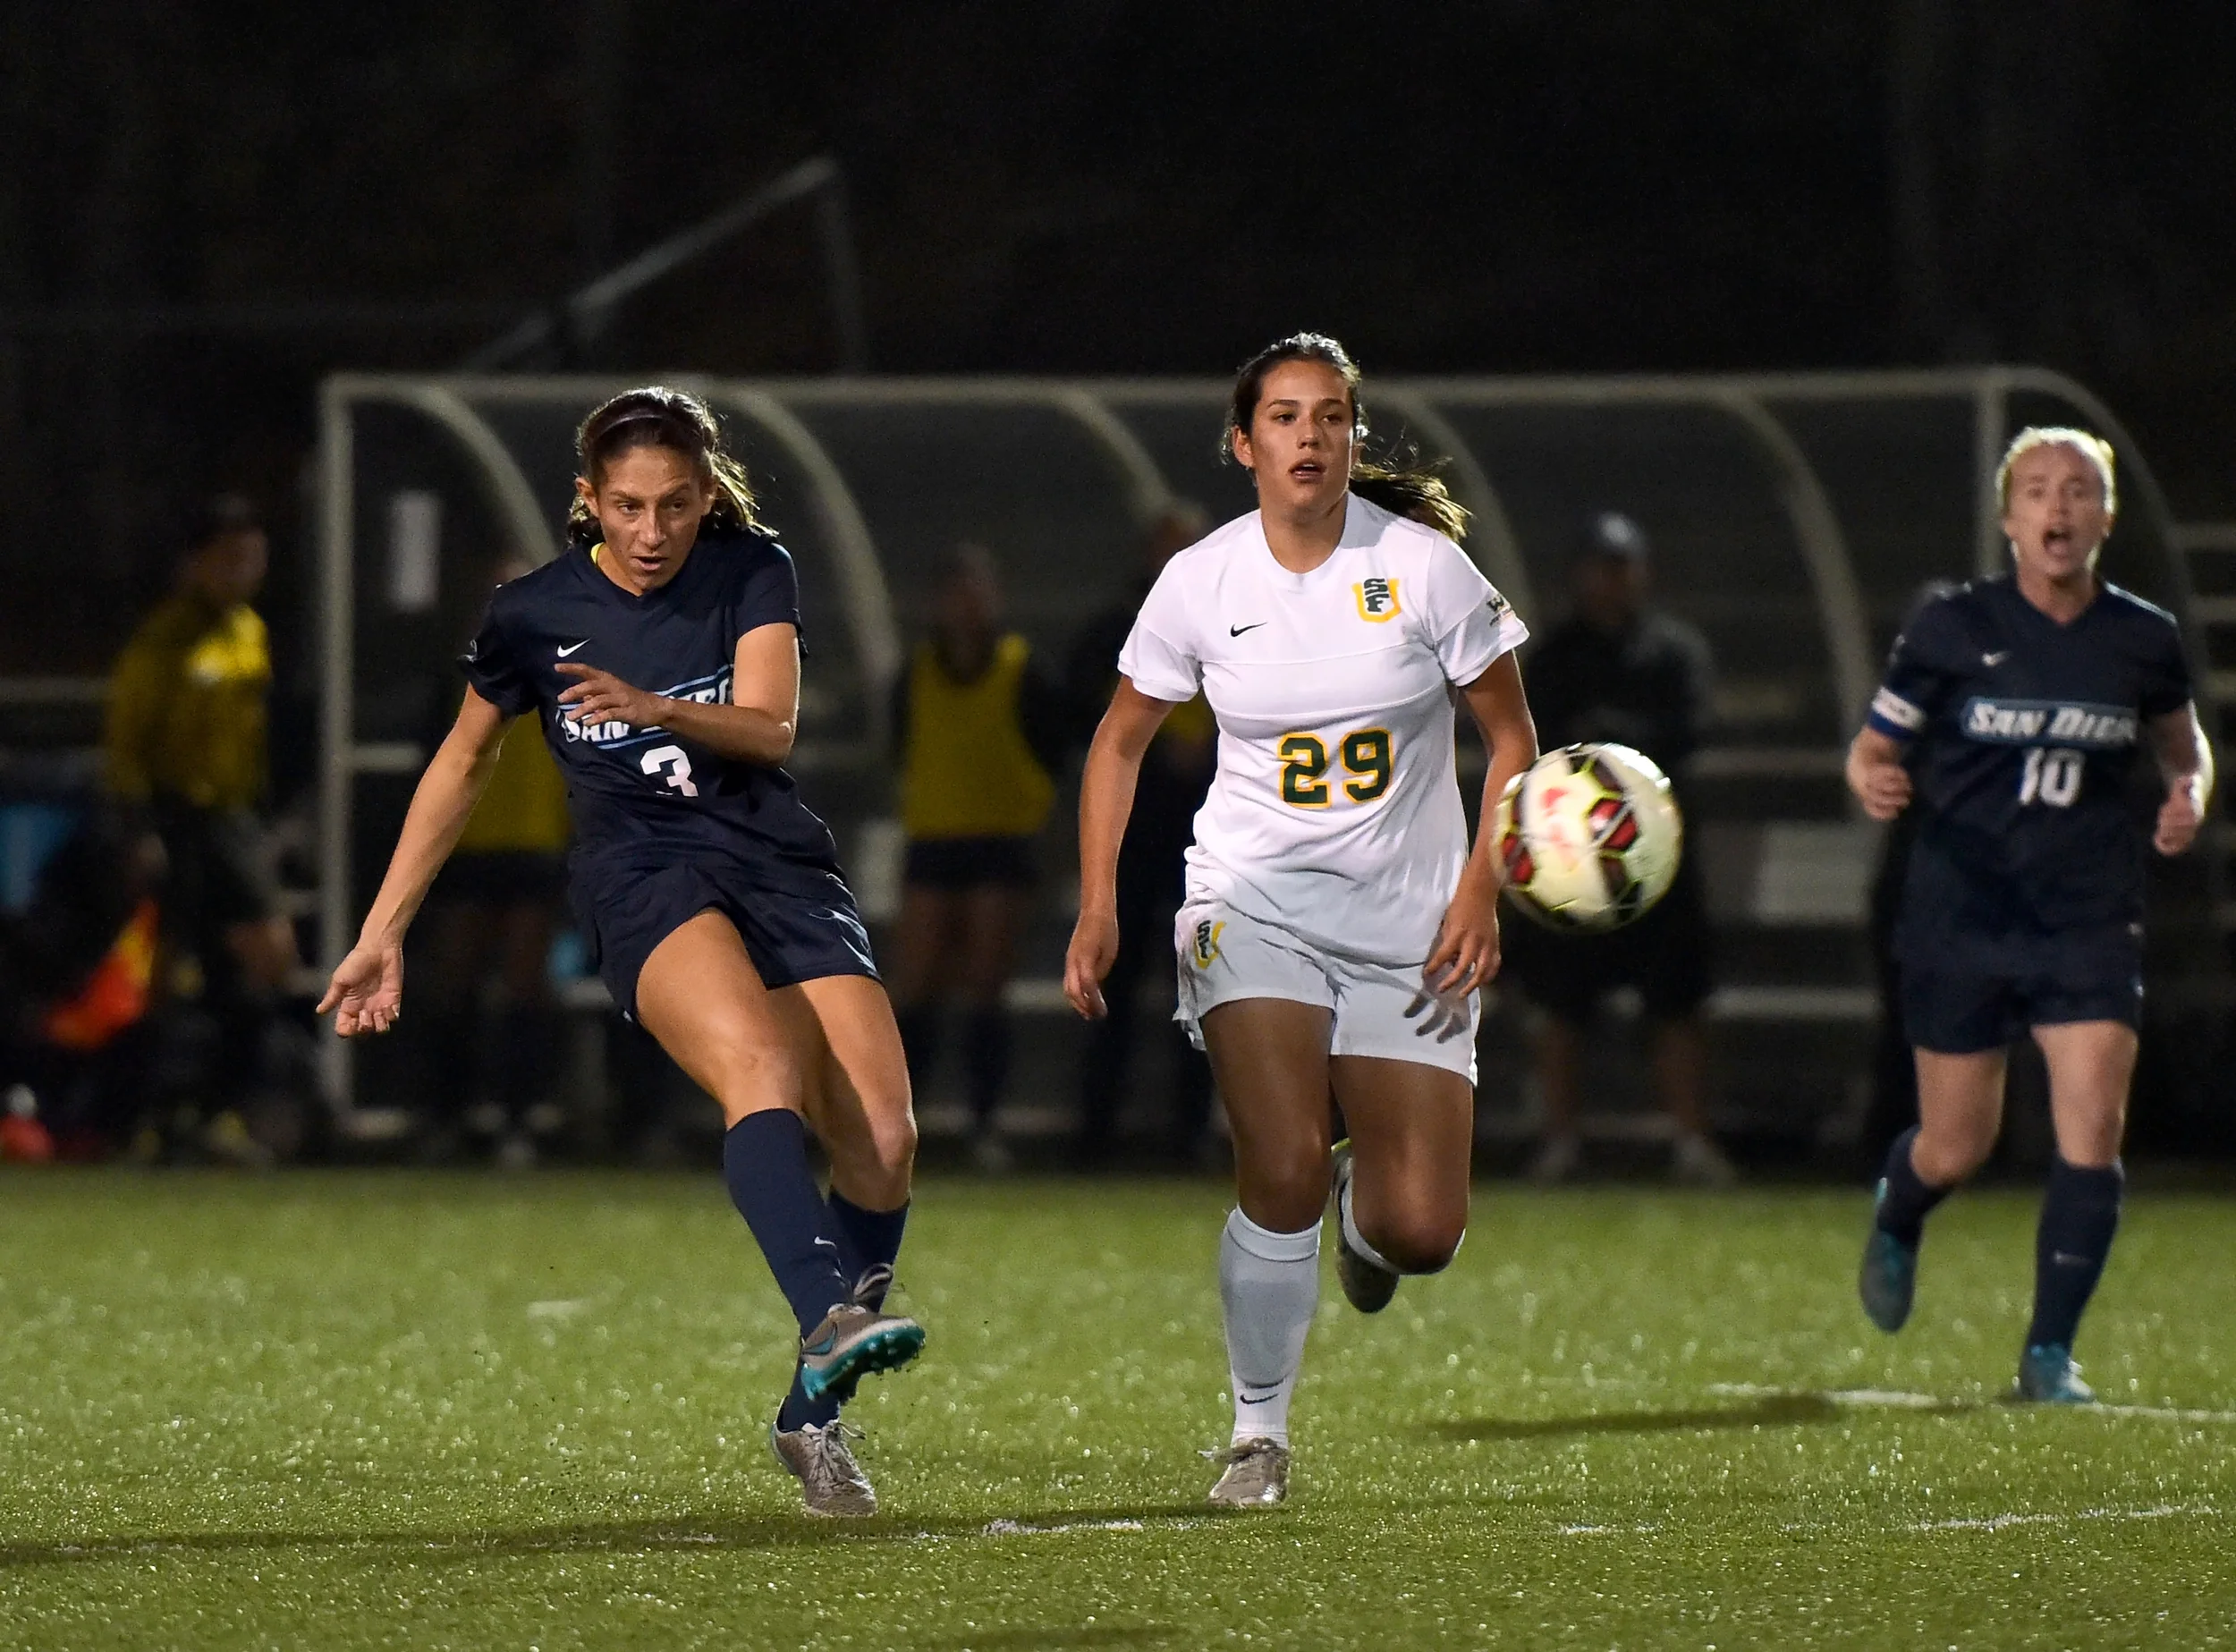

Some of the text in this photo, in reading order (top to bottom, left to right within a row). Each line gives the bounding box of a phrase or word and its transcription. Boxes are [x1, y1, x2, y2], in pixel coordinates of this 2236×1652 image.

[639, 745, 699, 798] 3
[1277, 727, 1394, 809] 29
[2019, 746, 2086, 807] 10
